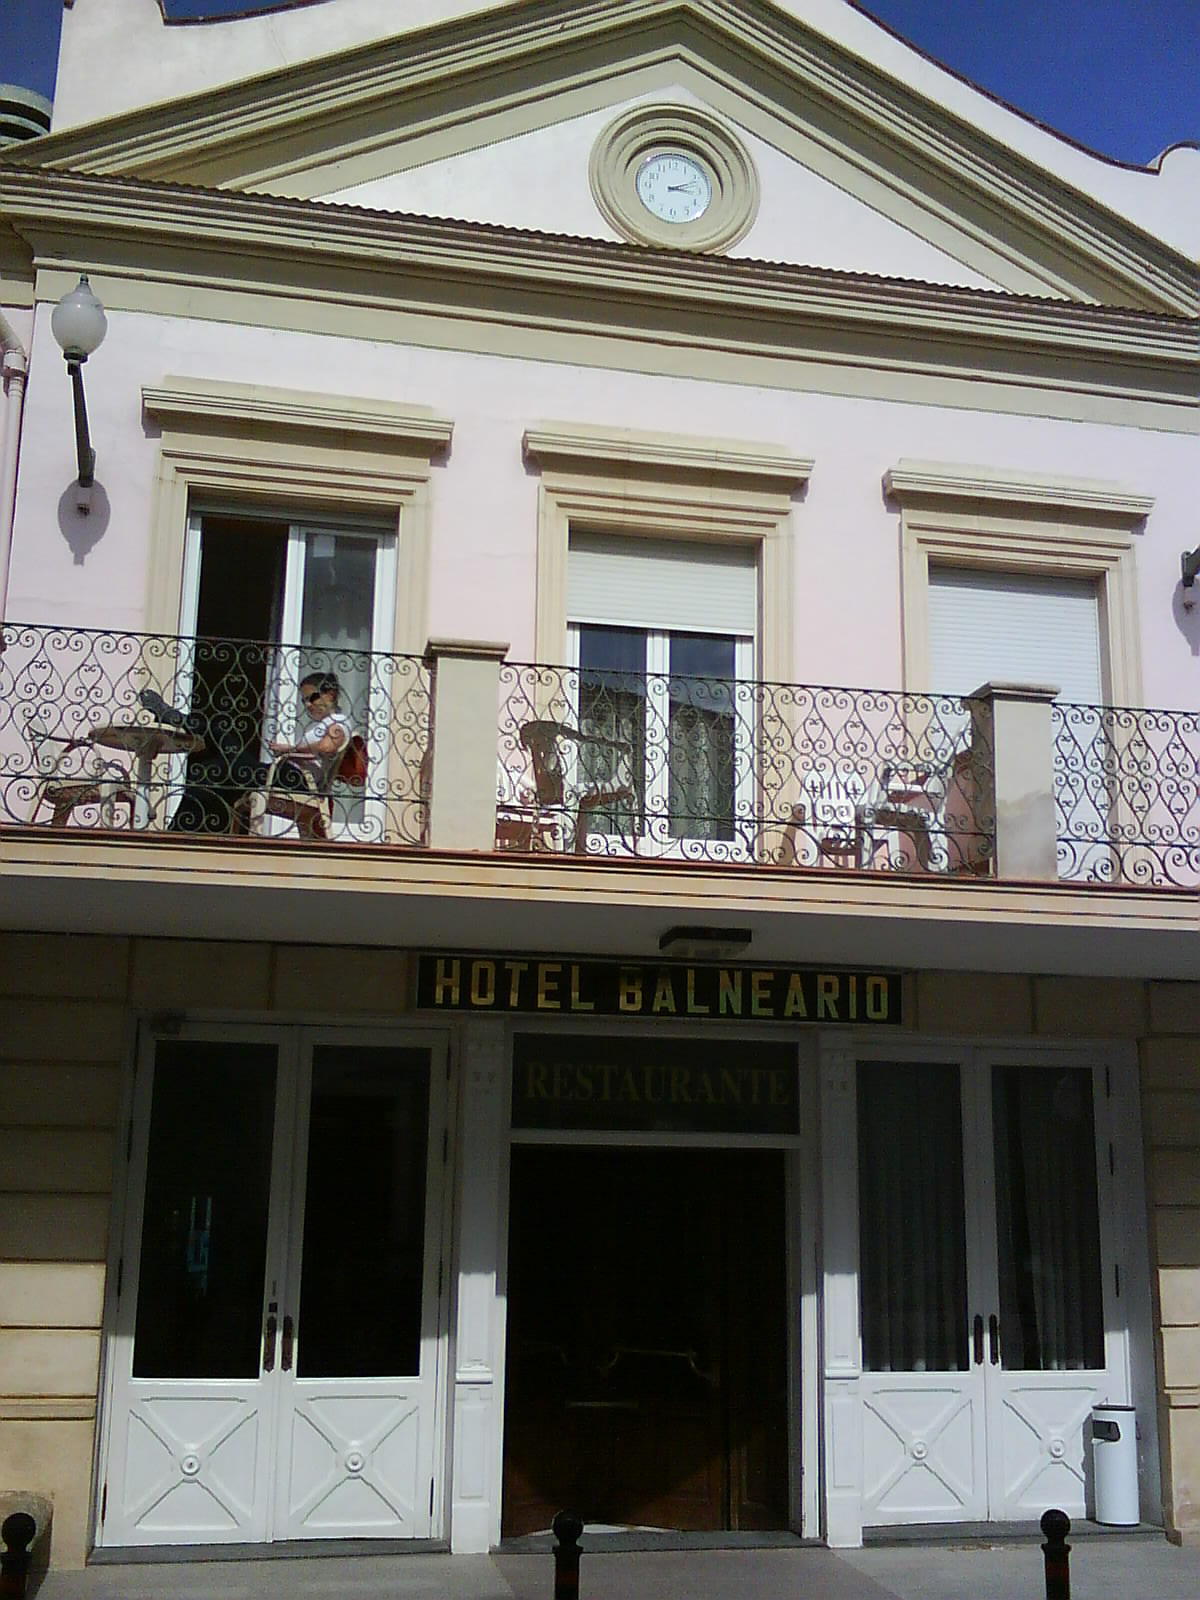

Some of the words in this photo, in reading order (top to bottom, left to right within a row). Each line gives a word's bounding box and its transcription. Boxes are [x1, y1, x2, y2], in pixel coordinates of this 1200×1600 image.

[434, 958, 594, 1010] HOTEL
[618, 965, 889, 1020] BALNEARIO
[526, 1061, 791, 1105] RESTAURANTE
